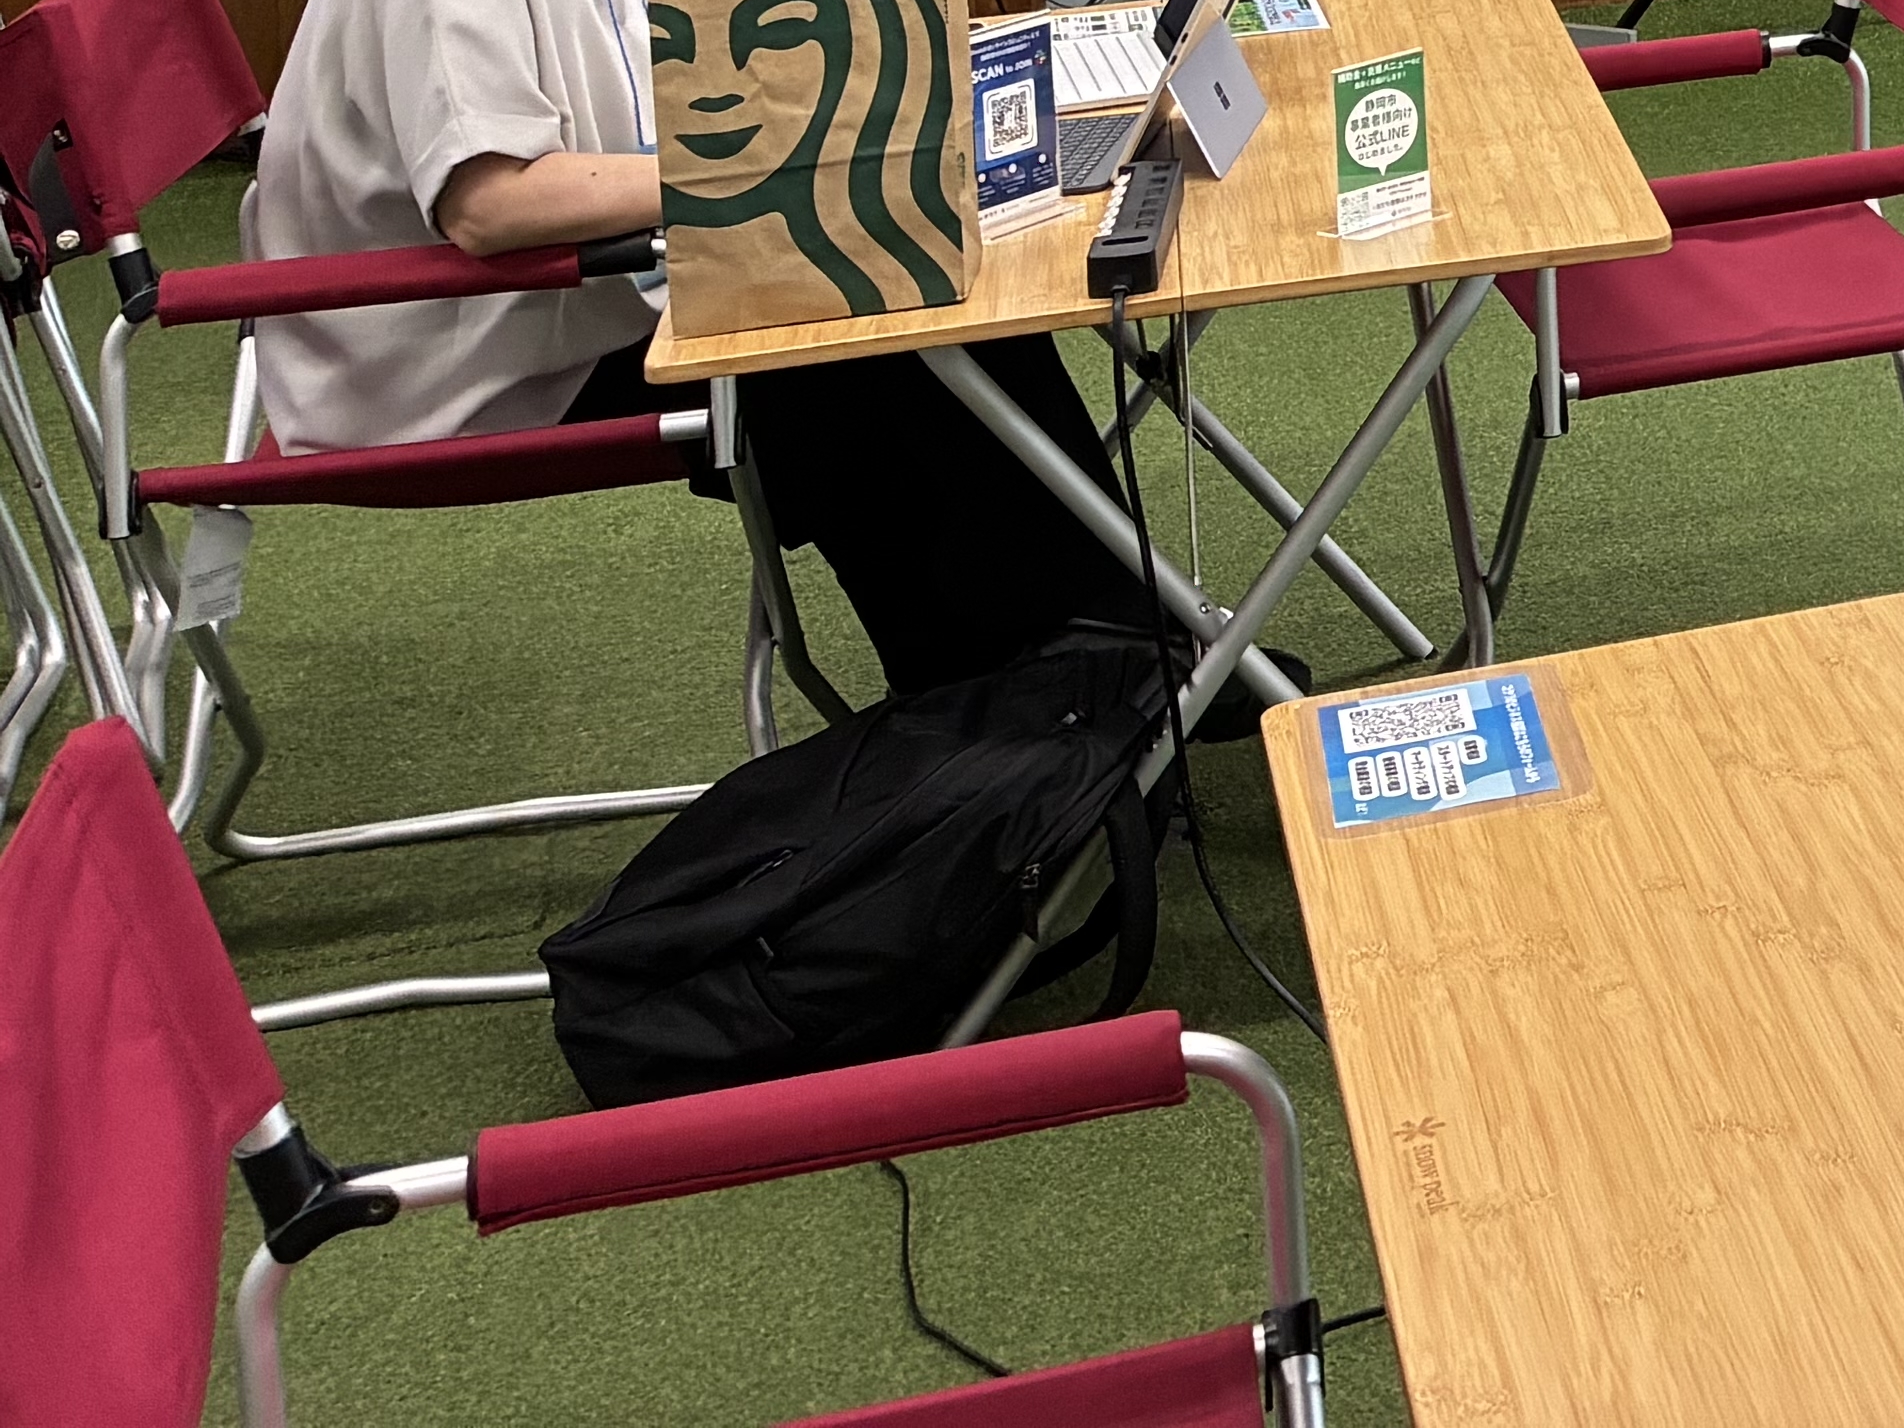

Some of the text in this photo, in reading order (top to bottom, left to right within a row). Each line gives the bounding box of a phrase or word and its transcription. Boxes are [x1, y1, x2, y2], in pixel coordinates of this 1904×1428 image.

[971, 62, 1004, 85] SCAN
[1364, 94, 1397, 113] 静岡市
[1354, 124, 1410, 150] 公式LINE
